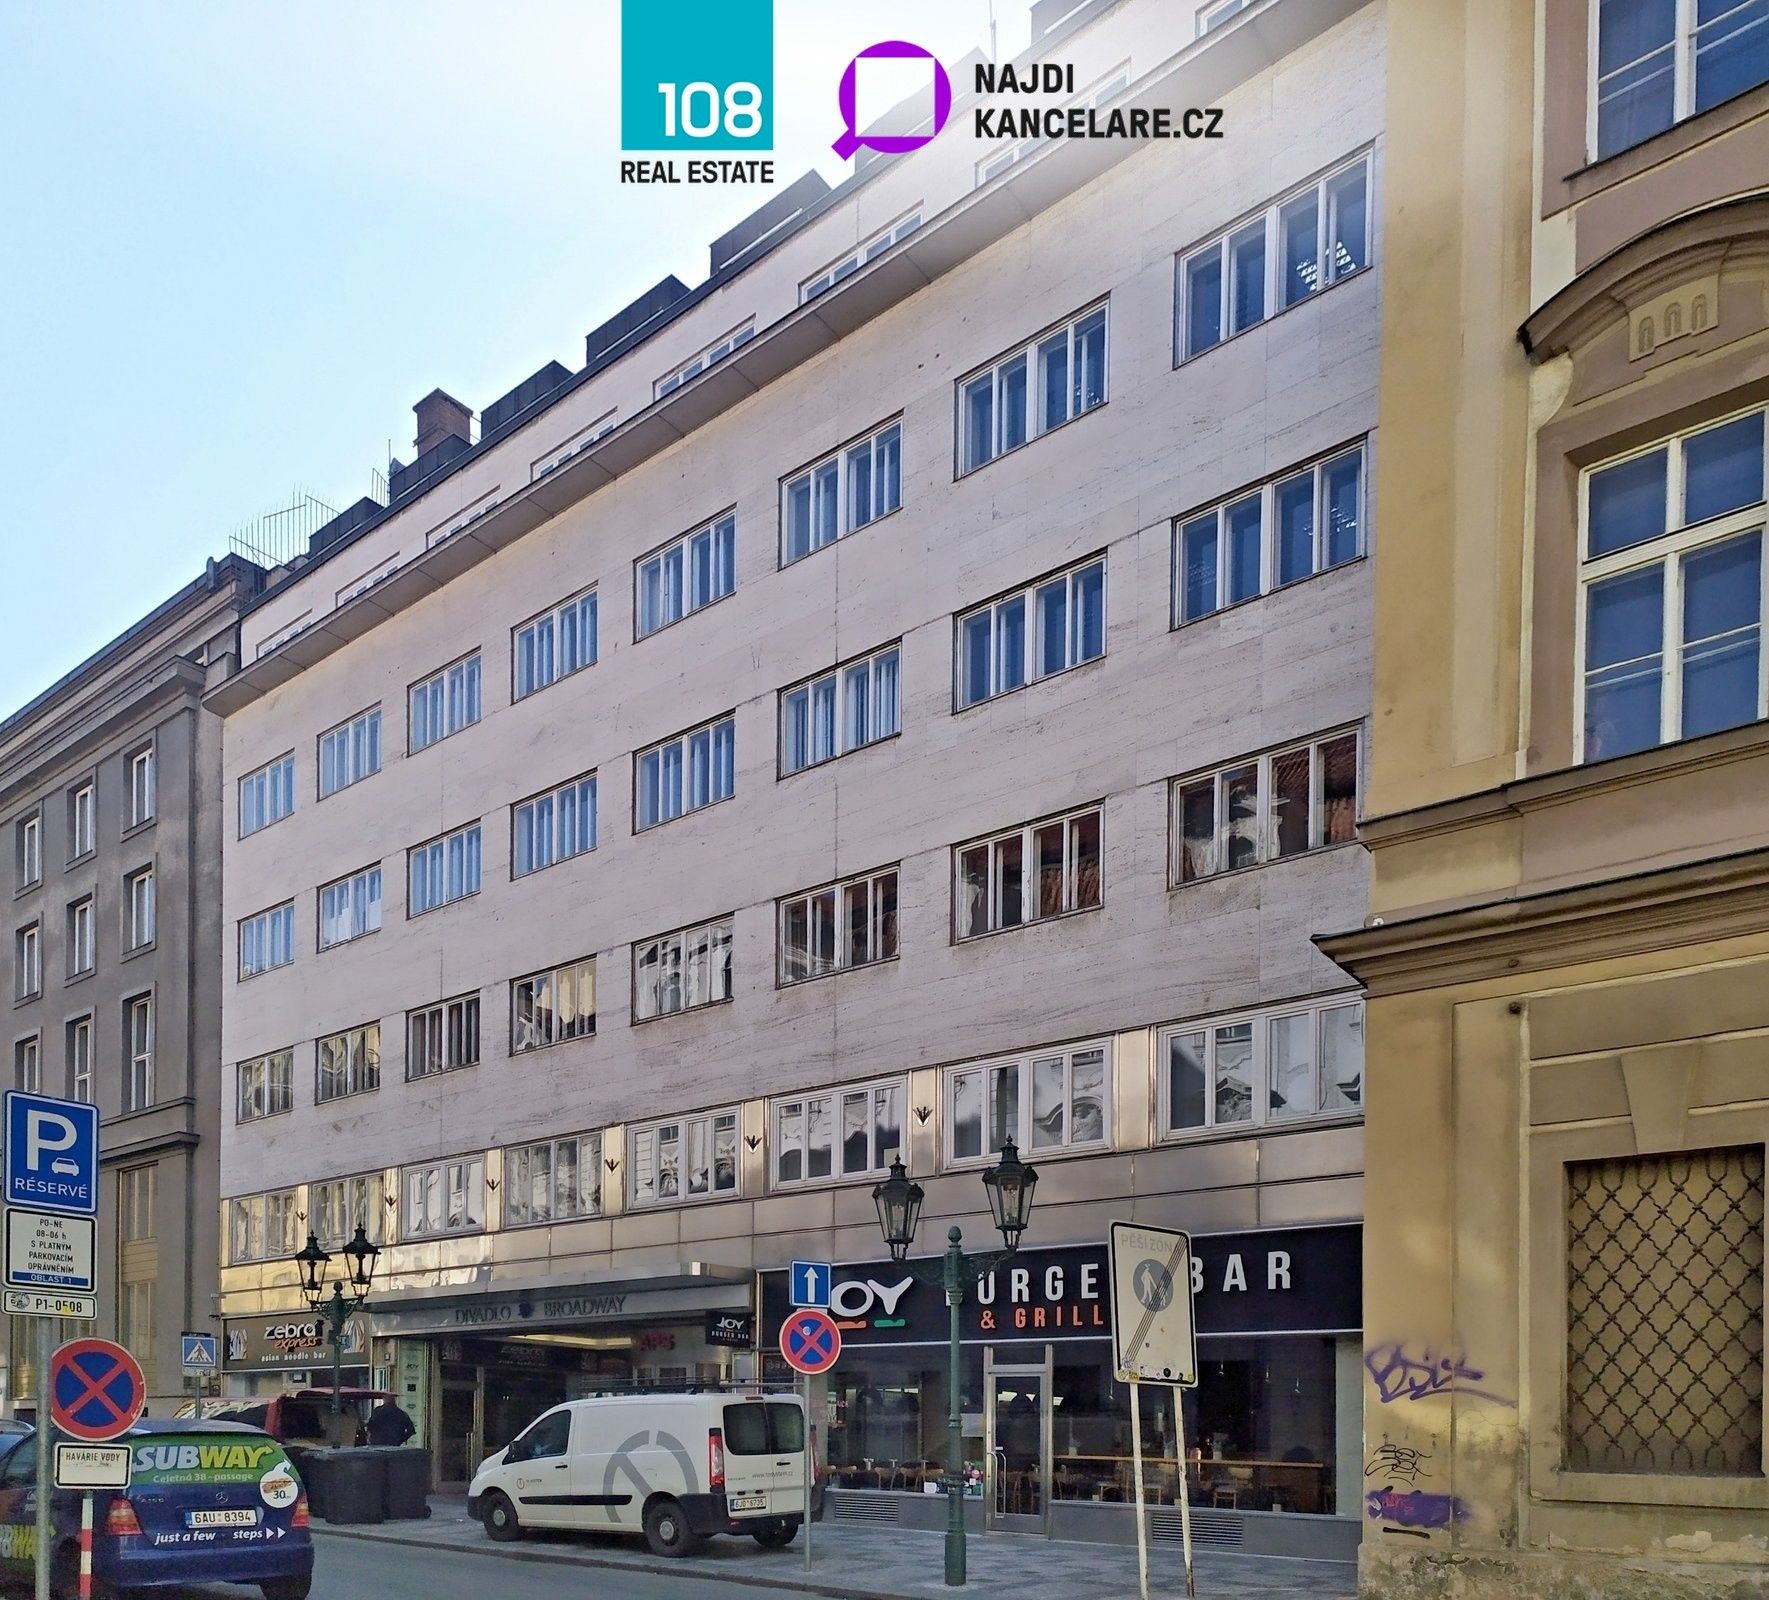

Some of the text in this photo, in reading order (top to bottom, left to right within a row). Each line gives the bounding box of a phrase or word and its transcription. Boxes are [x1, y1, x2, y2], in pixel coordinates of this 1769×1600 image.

[27, 1109, 77, 1171] P
[15, 1177, 88, 1199] RÉSERVÉ
[40, 1219, 63, 1228] PO-NE
[36, 1230, 66, 1240] 08-06 h
[39, 1241, 71, 1251] PLATNÝM
[29, 1251, 73, 1262] PARKOVACÍM
[28, 1262, 74, 1274] OPRÁVNĚNÍM
[31, 1274, 64, 1283] OBLAST
[831, 1277, 913, 1316] OY
[36, 1299, 82, 1312] P1-0508
[455, 1296, 626, 1323] DIVADLO BROADWAY
[716, 1317, 744, 1329] JOY
[980, 1305, 1104, 1329] & GRILL
[264, 1320, 318, 1340] zebra
[275, 1338, 318, 1352] express
[66, 1451, 121, 1462] HAVÁRIE VODY
[131, 1445, 273, 1474] SUBWAY
[273, 1490, 286, 1499] 30
[195, 1512, 251, 1524] 6AU 8394
[154, 1533, 180, 1545] just
[193, 1531, 216, 1541] few
[233, 1530, 263, 1540] steps
